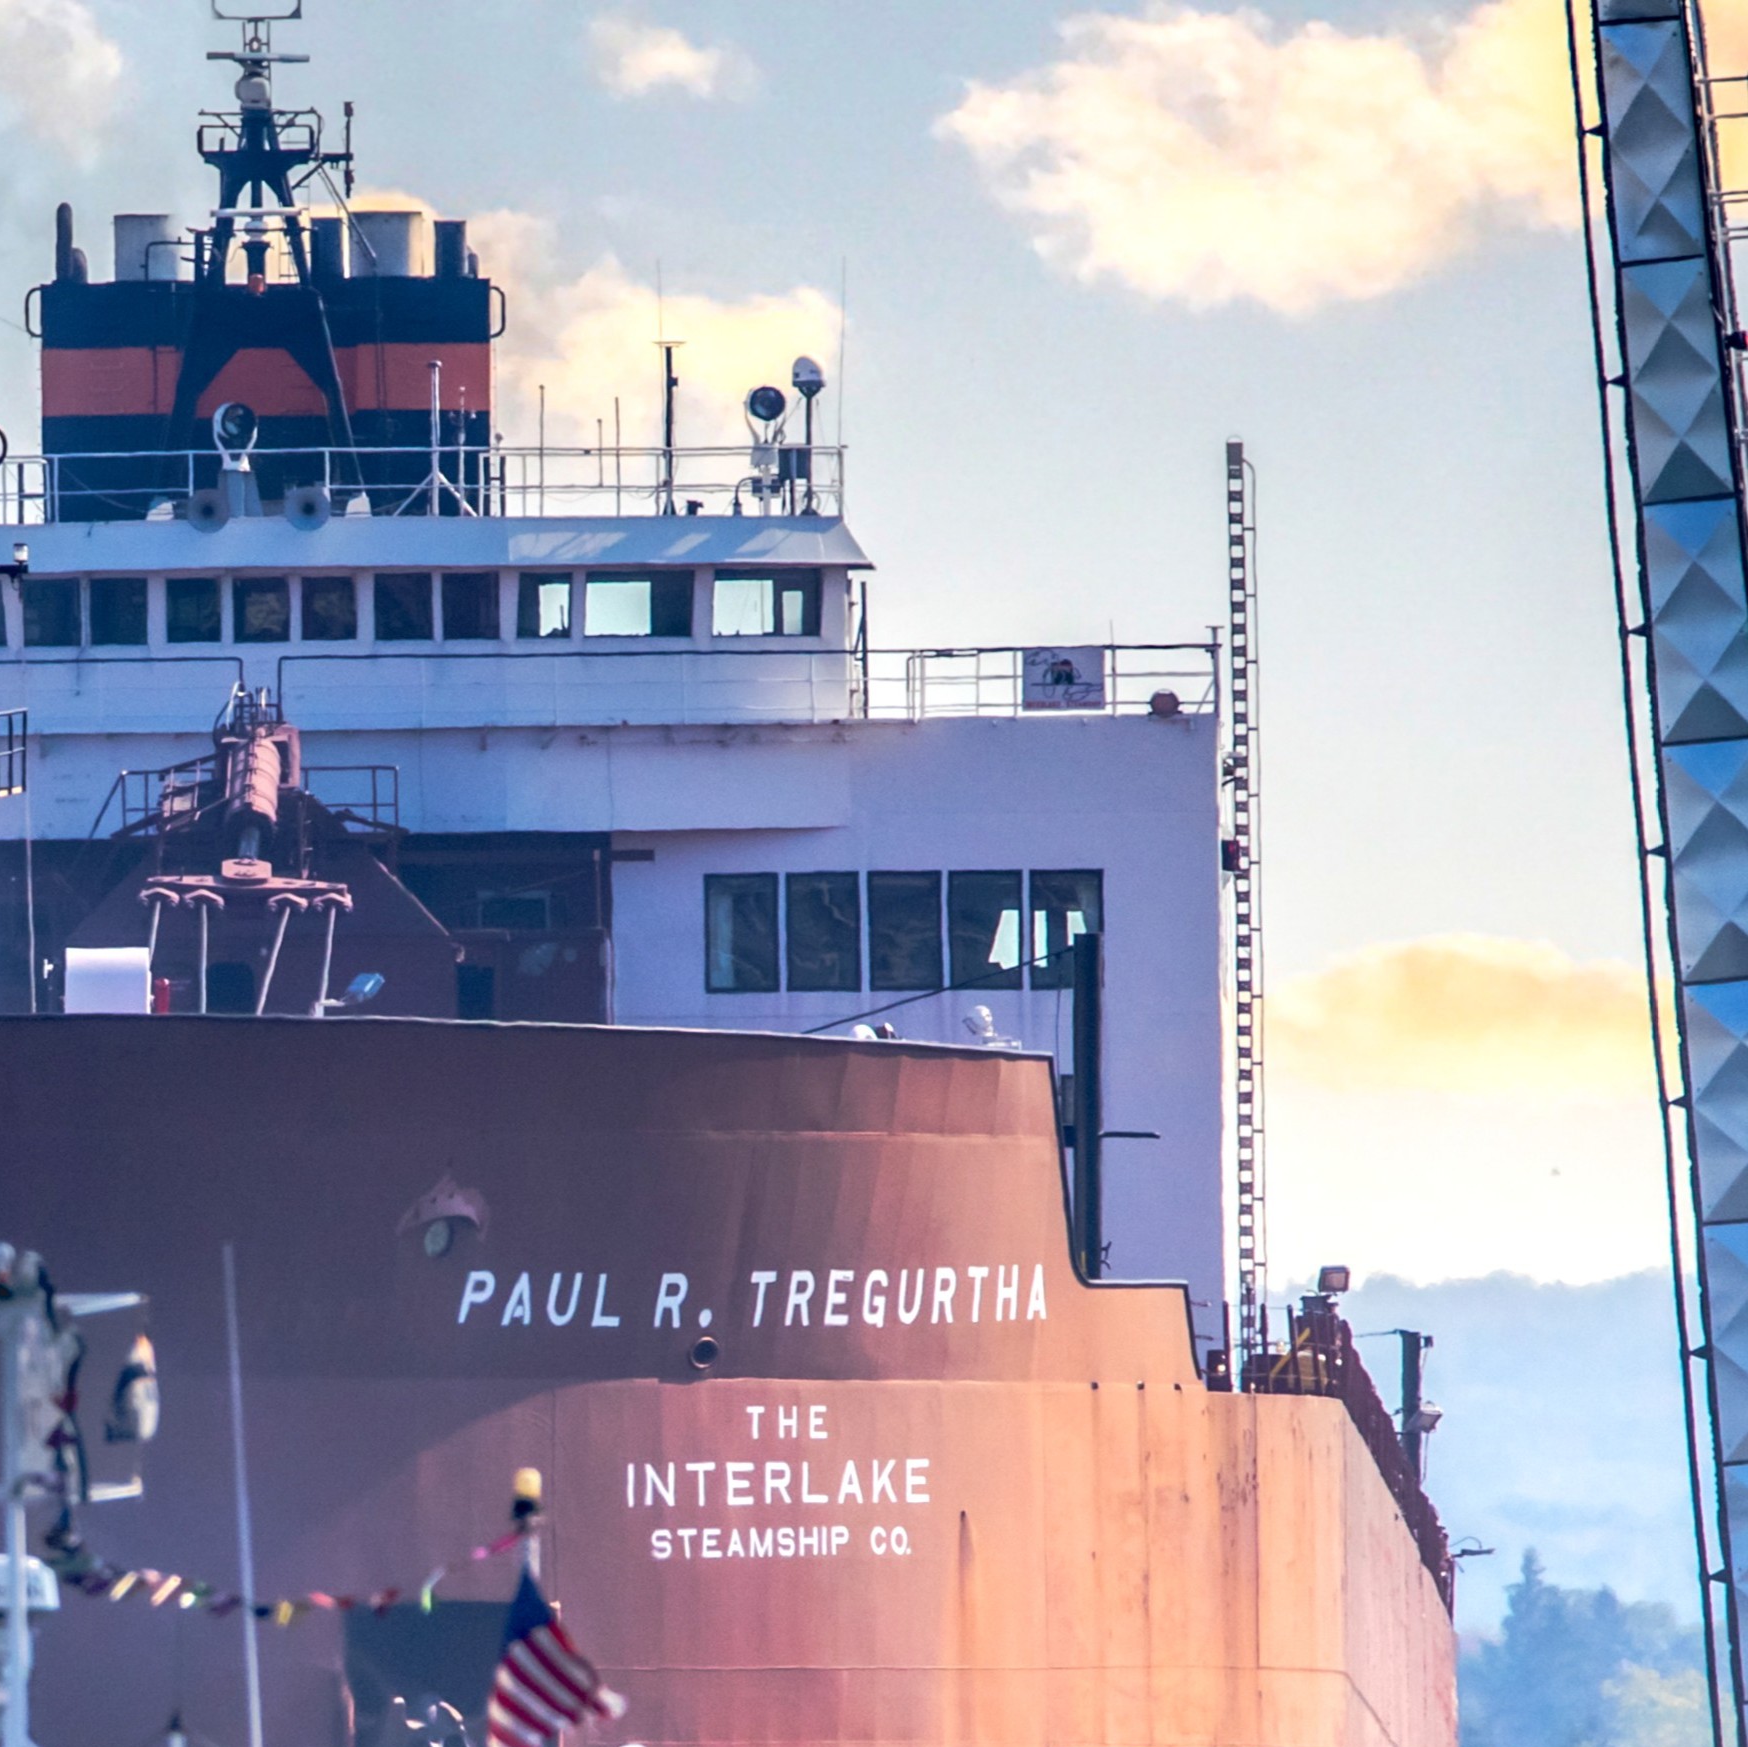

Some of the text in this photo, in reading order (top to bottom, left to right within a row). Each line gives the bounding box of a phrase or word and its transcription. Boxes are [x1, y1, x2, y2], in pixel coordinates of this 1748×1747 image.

[457, 1262, 1049, 1330] PAUL R. TREGURTHA
[745, 1403, 830, 1441] THE
[626, 1457, 932, 1508] INTERLAKE
[650, 1524, 913, 1560] STEAMSHIP CO.
